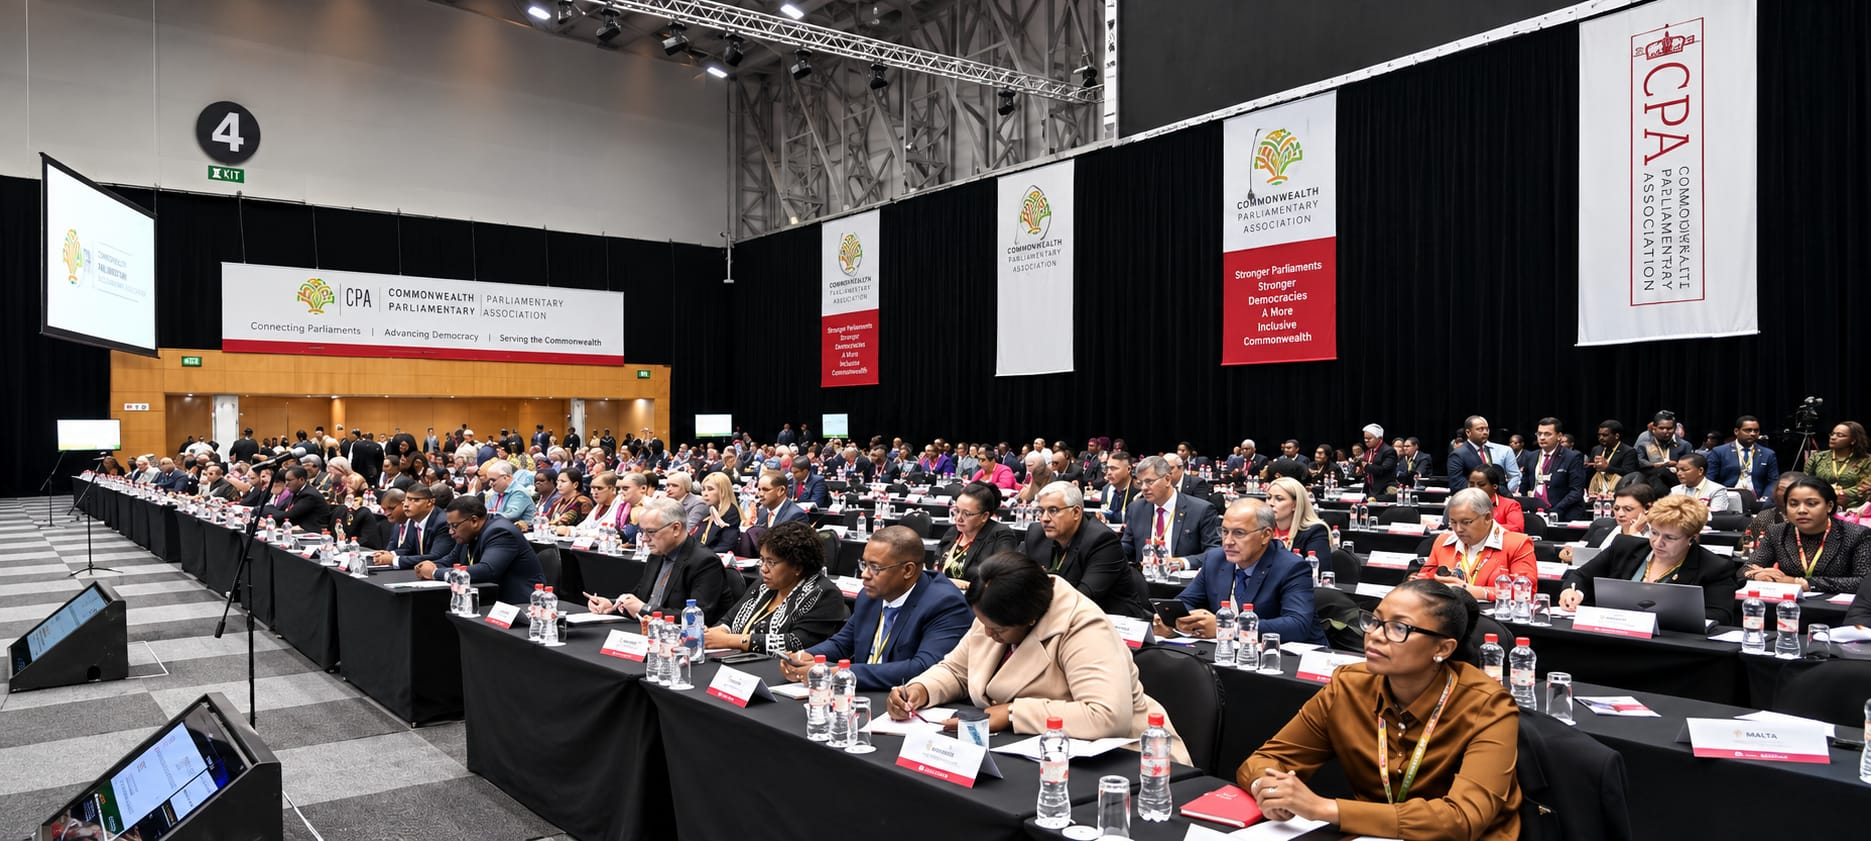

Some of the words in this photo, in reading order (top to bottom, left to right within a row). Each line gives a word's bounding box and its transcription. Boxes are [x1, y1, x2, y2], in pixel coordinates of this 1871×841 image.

[1643, 62, 1690, 166] CPA
[212, 112, 244, 152] 4
[1237, 187, 1319, 210] COMMONWEALTH
[1238, 200, 1319, 222] PARLIAMENTARY
[1244, 215, 1311, 234] ASSOCIATION
[1643, 172, 1654, 291] ASSOCIATION
[1235, 268, 1270, 280] Stronger
[1272, 261, 1322, 275] Parliaments
[1258, 280, 1296, 291] Stronger
[346, 287, 372, 308] CPA
[388, 288, 474, 302] COMMONWEALTH
[486, 295, 564, 308] PARLIAMENTARY
[1248, 291, 1308, 306] Democracies
[388, 302, 476, 316] PARLIAMENTARY
[483, 309, 547, 320] ASSOCIATION
[1262, 308, 1268, 318] A
[1270, 307, 1294, 317] More
[250, 321, 305, 334] Connecting
[308, 324, 361, 336] Parliaments
[384, 328, 430, 340] Advancing
[432, 330, 479, 342] Democracy
[500, 334, 528, 345] Serving
[530, 336, 543, 344] the
[545, 336, 602, 347] Commonwealth
[1258, 320, 1297, 332] Inclusive
[1244, 332, 1312, 346] Commonwealth
[1746, 732, 1778, 740] MALTA
